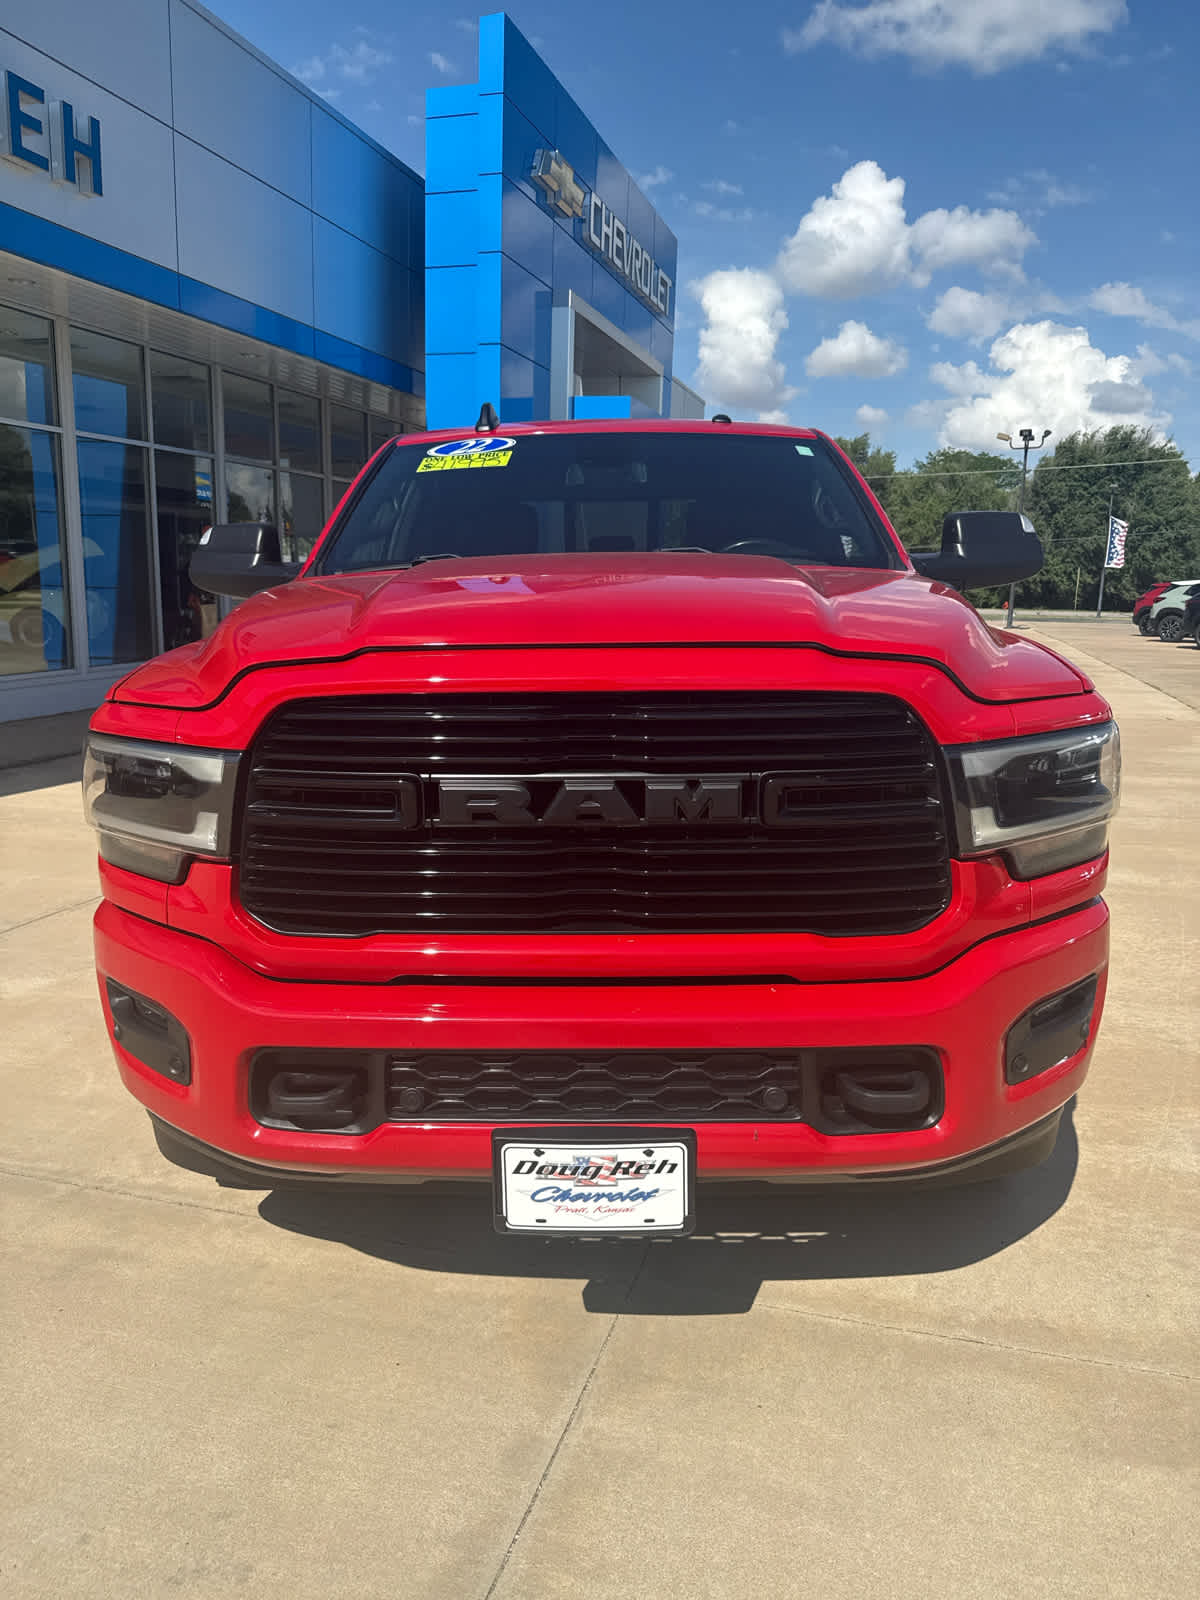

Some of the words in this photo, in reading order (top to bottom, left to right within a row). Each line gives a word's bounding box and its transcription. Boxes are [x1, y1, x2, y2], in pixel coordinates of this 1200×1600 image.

[590, 191, 672, 316] CHEVROLET
[448, 439, 494, 454] 22
[439, 779, 741, 825] RAM
[512, 1160, 604, 1180] Doug
[609, 1160, 678, 1176] Reh
[530, 1186, 660, 1203] Chevrolet
[593, 1205, 636, 1213] Kansas
